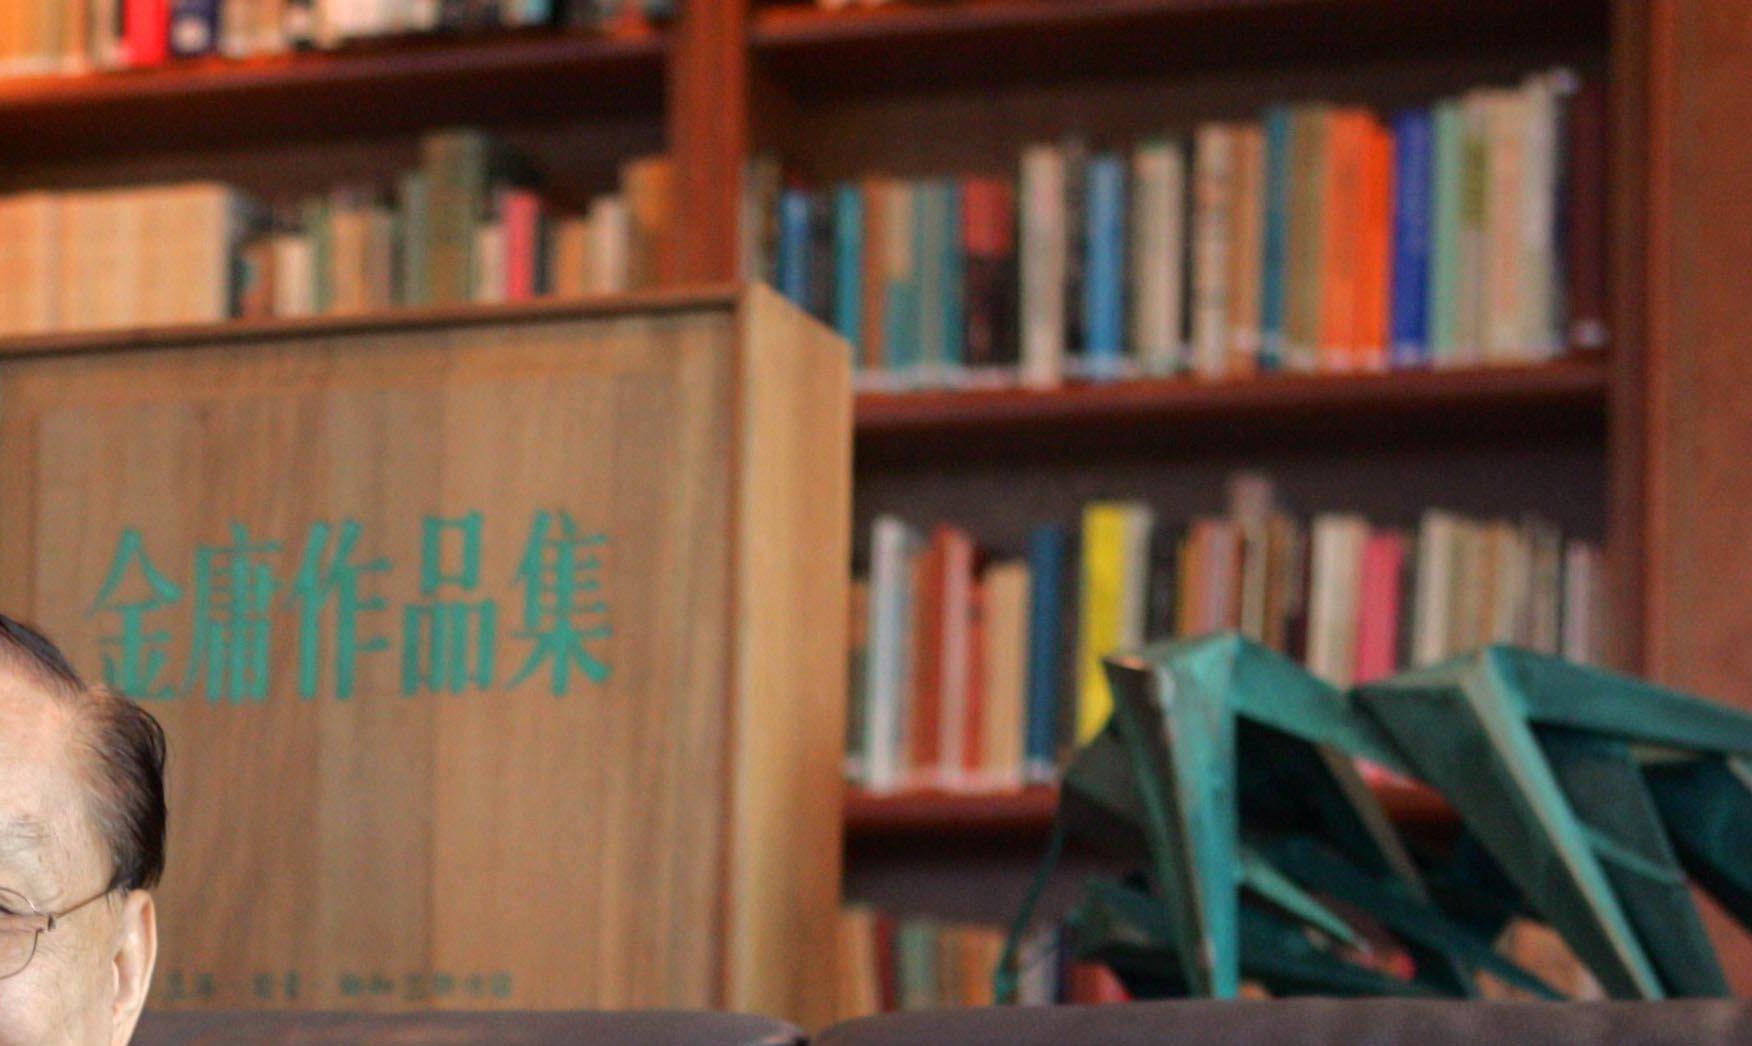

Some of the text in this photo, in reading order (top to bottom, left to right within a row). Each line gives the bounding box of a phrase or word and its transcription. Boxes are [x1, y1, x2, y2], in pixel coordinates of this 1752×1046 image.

[83, 508, 614, 704] 金庸作品集
